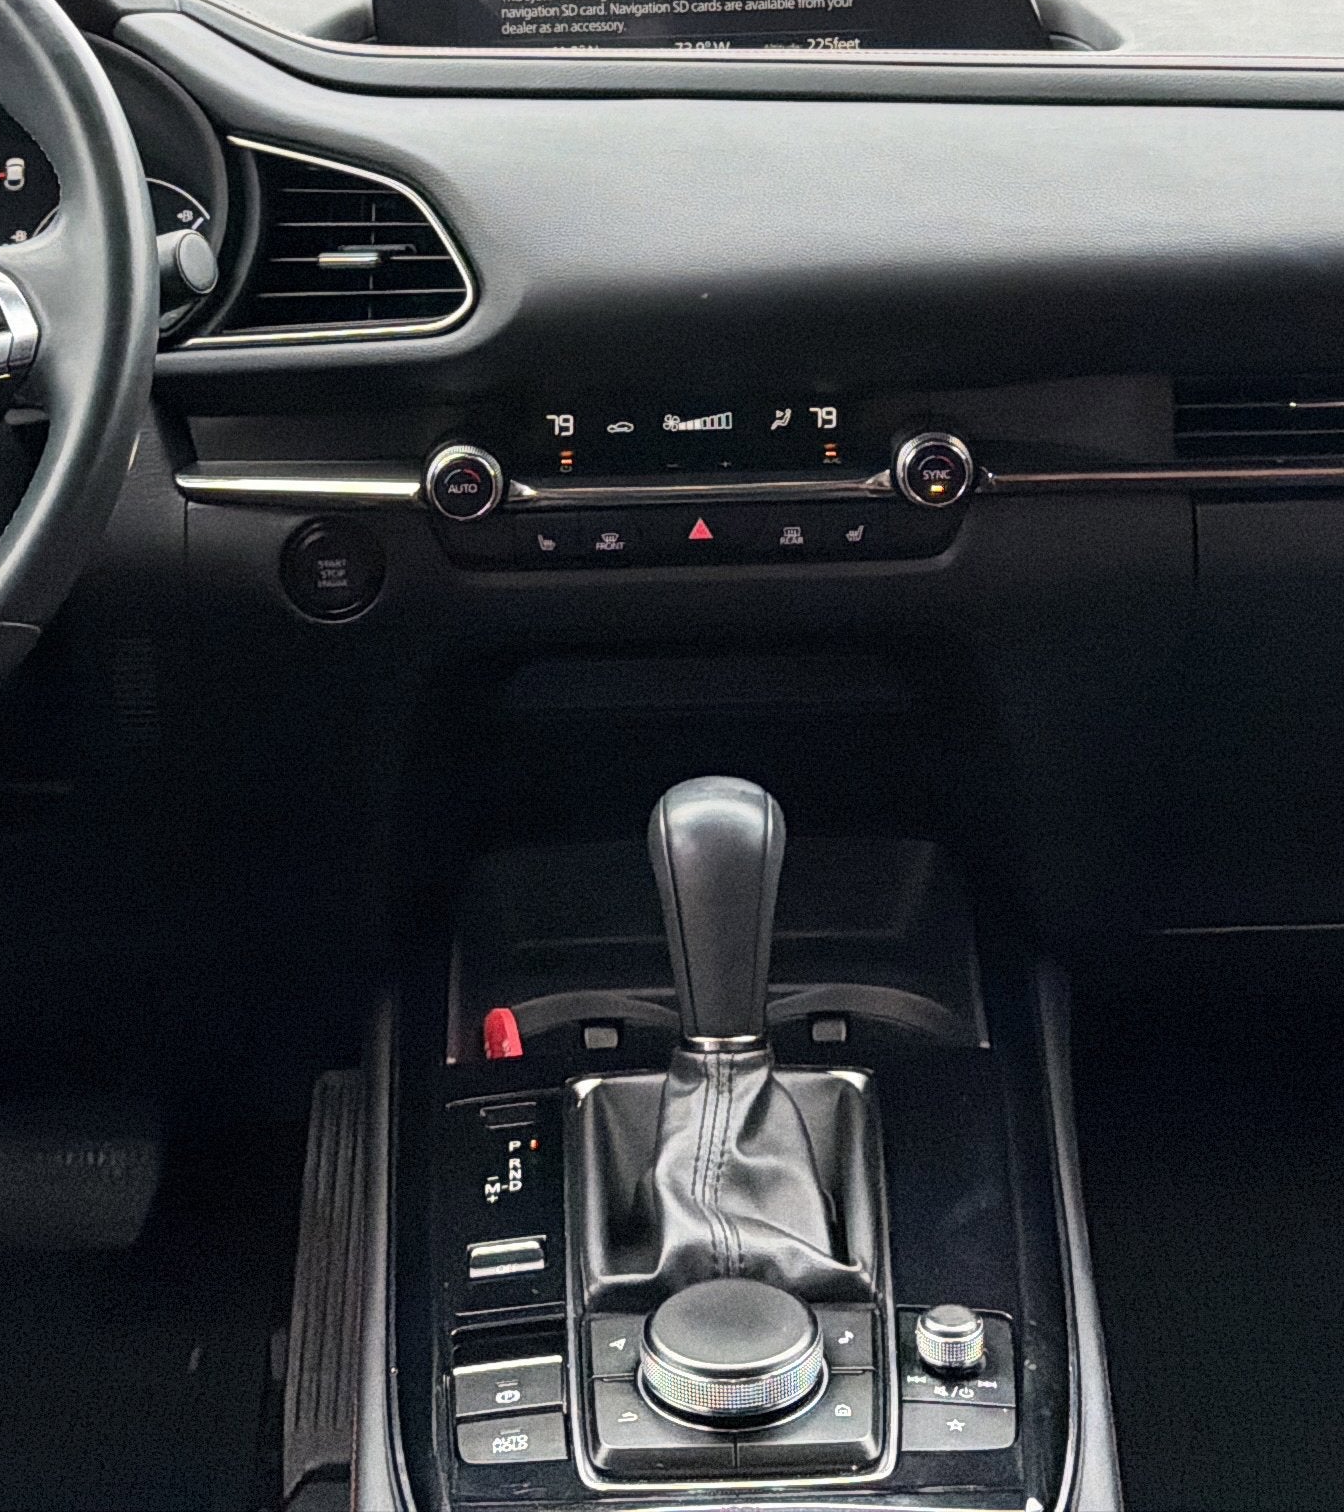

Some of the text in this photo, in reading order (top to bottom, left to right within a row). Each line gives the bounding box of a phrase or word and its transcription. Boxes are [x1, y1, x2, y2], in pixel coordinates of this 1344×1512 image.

[501, 4, 559, 20] navigation
[561, 4, 578, 17] SD
[579, 2, 607, 16] card.
[610, 1, 670, 17] Navigation
[673, 0, 689, 13] SD
[691, 0, 722, 13] cards
[724, 0, 742, 12] are
[501, 20, 627, 35] dealer as an accessory.
[809, 407, 837, 429] 79
[546, 414, 574, 436] 79
[922, 469, 952, 480] SYNC
[447, 484, 478, 494] AUTO
[596, 541, 625, 551] FRONT
[780, 536, 804, 545] REAR
[508, 1140, 522, 1152] P
[508, 1157, 521, 1169] R
[508, 1168, 522, 1181] N
[484, 1180, 523, 1195] M D
[495, 1434, 528, 1445] AUTO
[492, 1442, 528, 1454] HOLD
